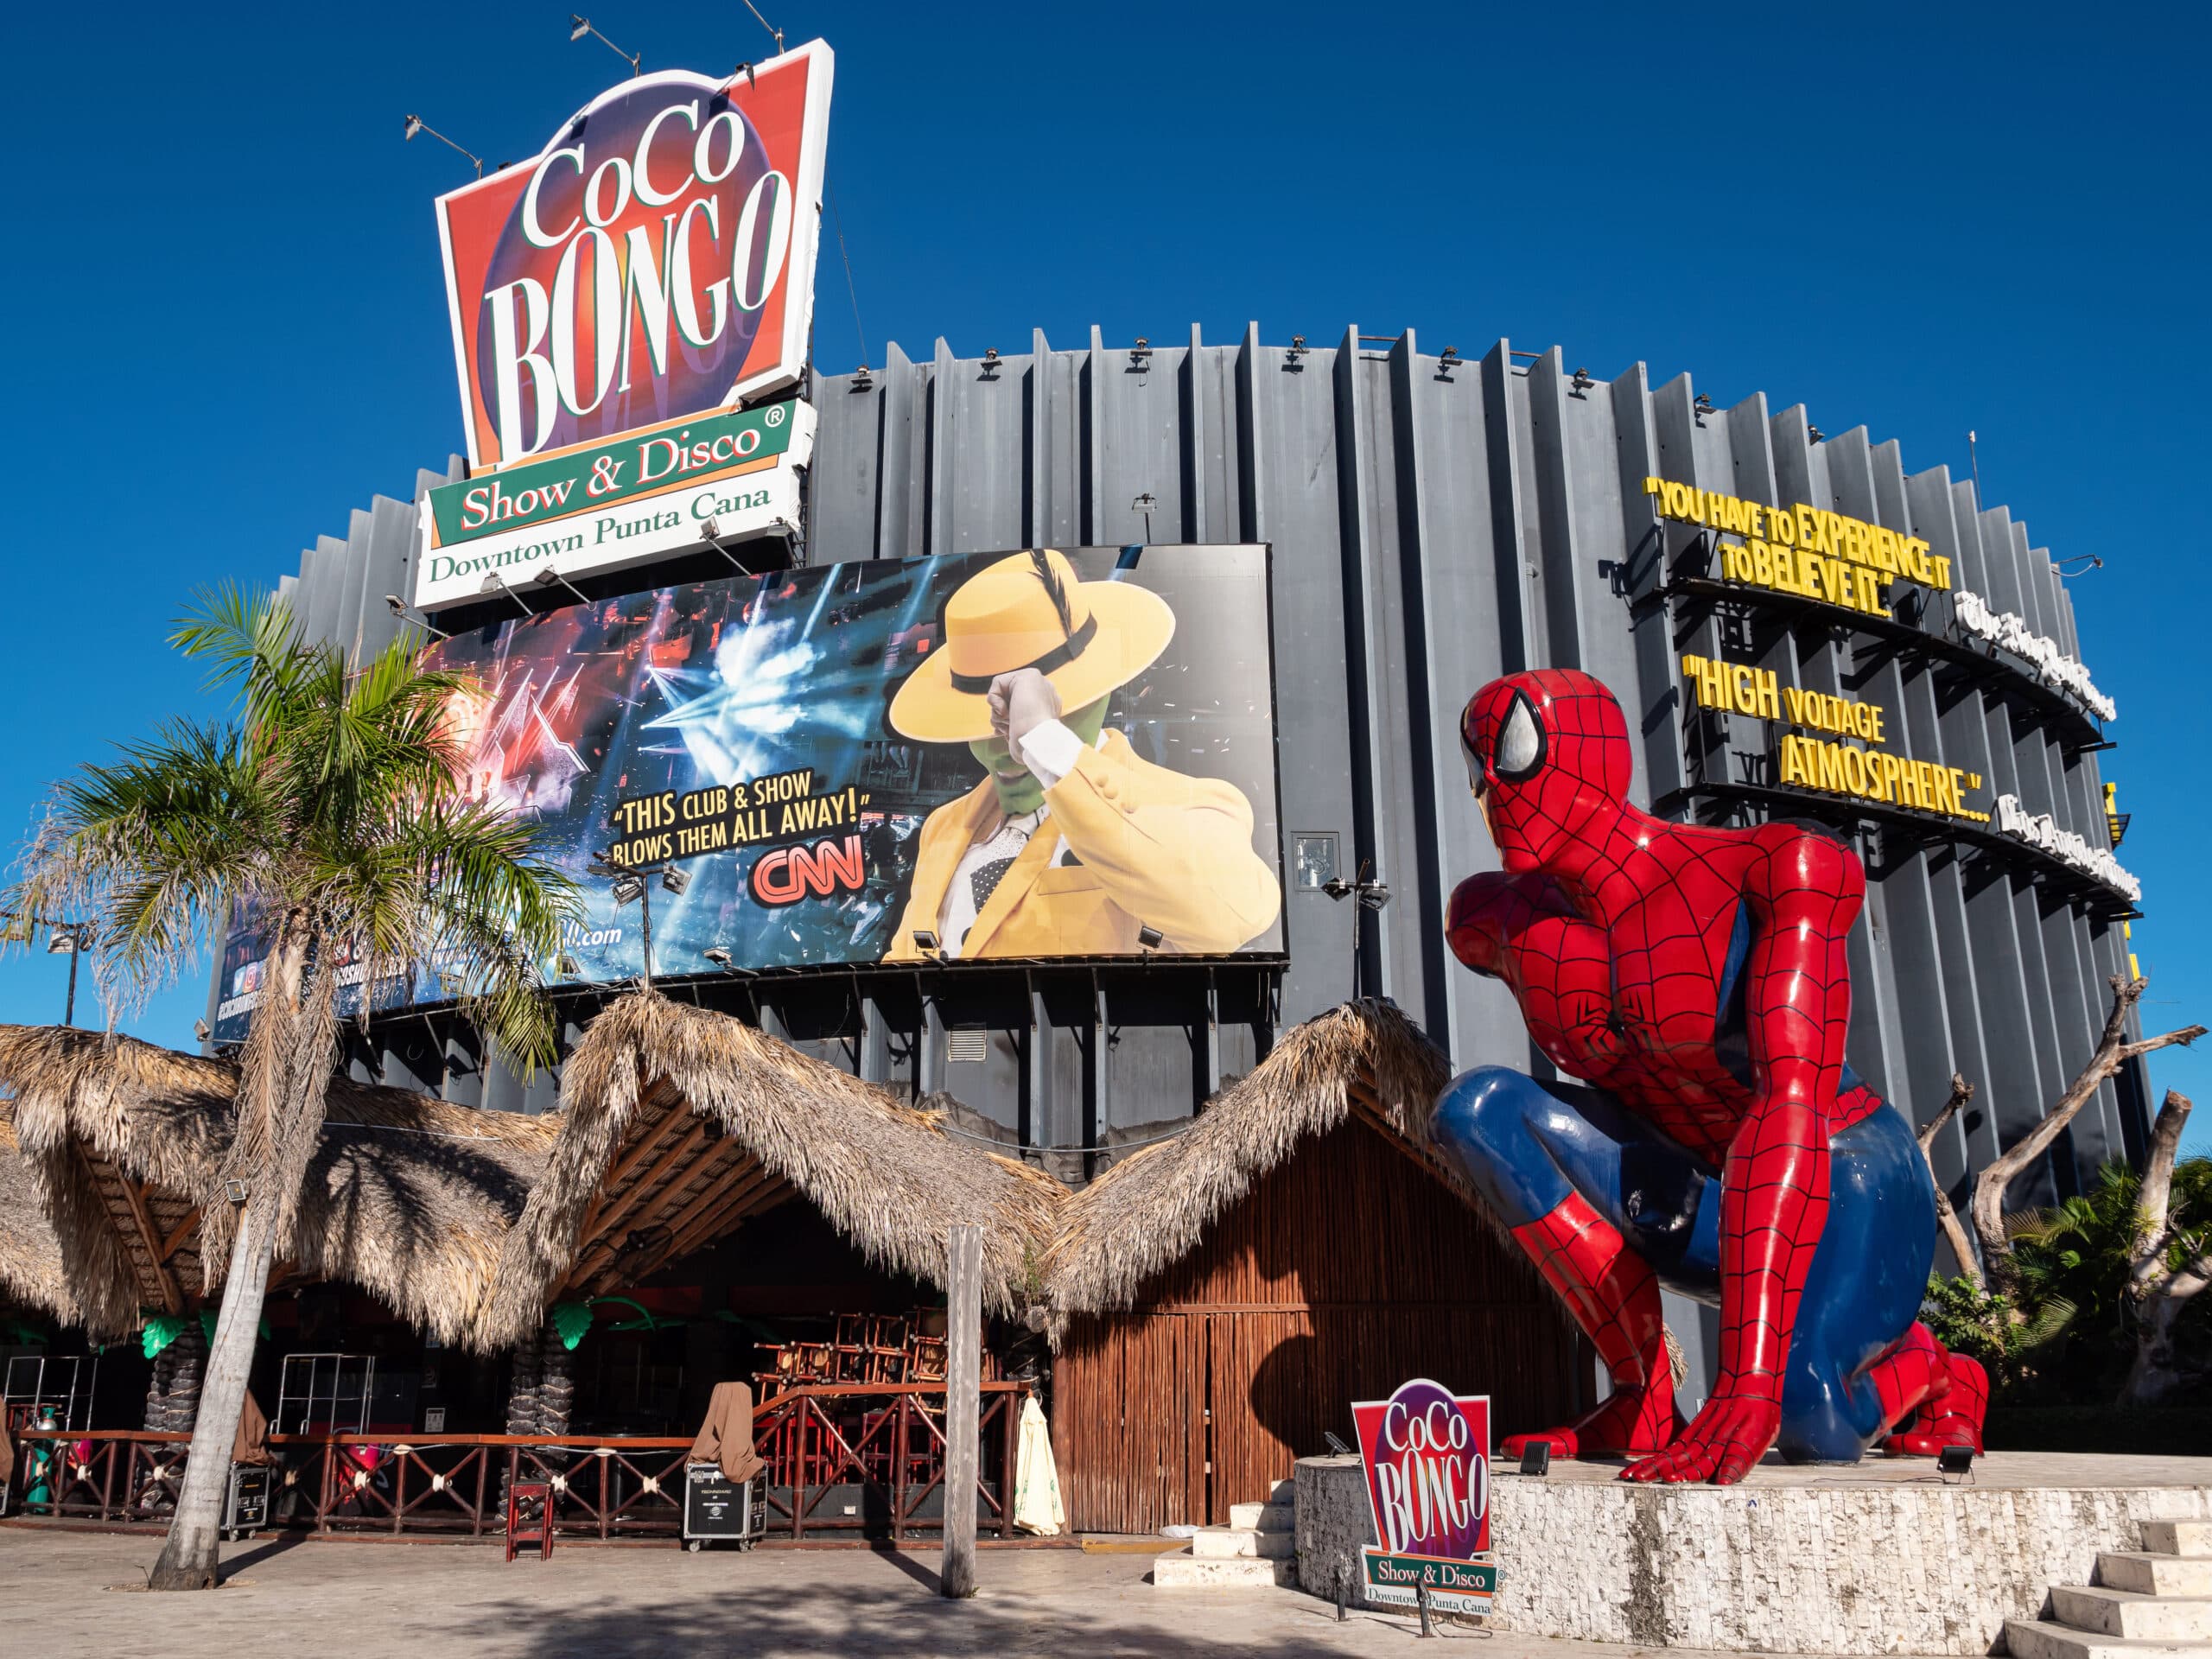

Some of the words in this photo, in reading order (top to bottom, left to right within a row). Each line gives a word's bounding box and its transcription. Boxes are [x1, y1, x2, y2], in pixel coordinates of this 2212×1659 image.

[522, 99, 746, 249] CoCo
[485, 170, 793, 472] BONGO
[461, 478, 578, 531] Show
[585, 454, 627, 499] &
[635, 429, 761, 486] Disco
[429, 532, 583, 582] Downtown
[594, 510, 681, 545] Punta
[691, 488, 772, 521] Cana
[1703, 491, 1764, 538] HAVE
[1762, 505, 1796, 546] TO
[1790, 503, 1934, 589] EXPERIENCE
[1930, 555, 1951, 591] IT
[1718, 542, 1753, 585] TO
[1745, 538, 1854, 608] BELIEVE
[1783, 686, 1886, 743] VOLTAGE
[682, 788, 728, 821] CLUB
[734, 786, 749, 810] &
[754, 771, 812, 805] SHOW
[613, 833, 673, 868] BLOWS
[677, 821, 728, 855] THEM
[733, 810, 773, 844] ALL
[753, 834, 865, 905] CNN
[1384, 1401, 1468, 1452] CoCo
[1375, 1447, 1488, 1556] BONGO
[1368, 1587, 1422, 1605] Downtow
[1427, 1594, 1459, 1611] Punta
[1462, 1599, 1491, 1614] Cana
[1377, 1560, 1420, 1583] Show
[1423, 1564, 1437, 1585] &
[1441, 1565, 1486, 1589] Disco
